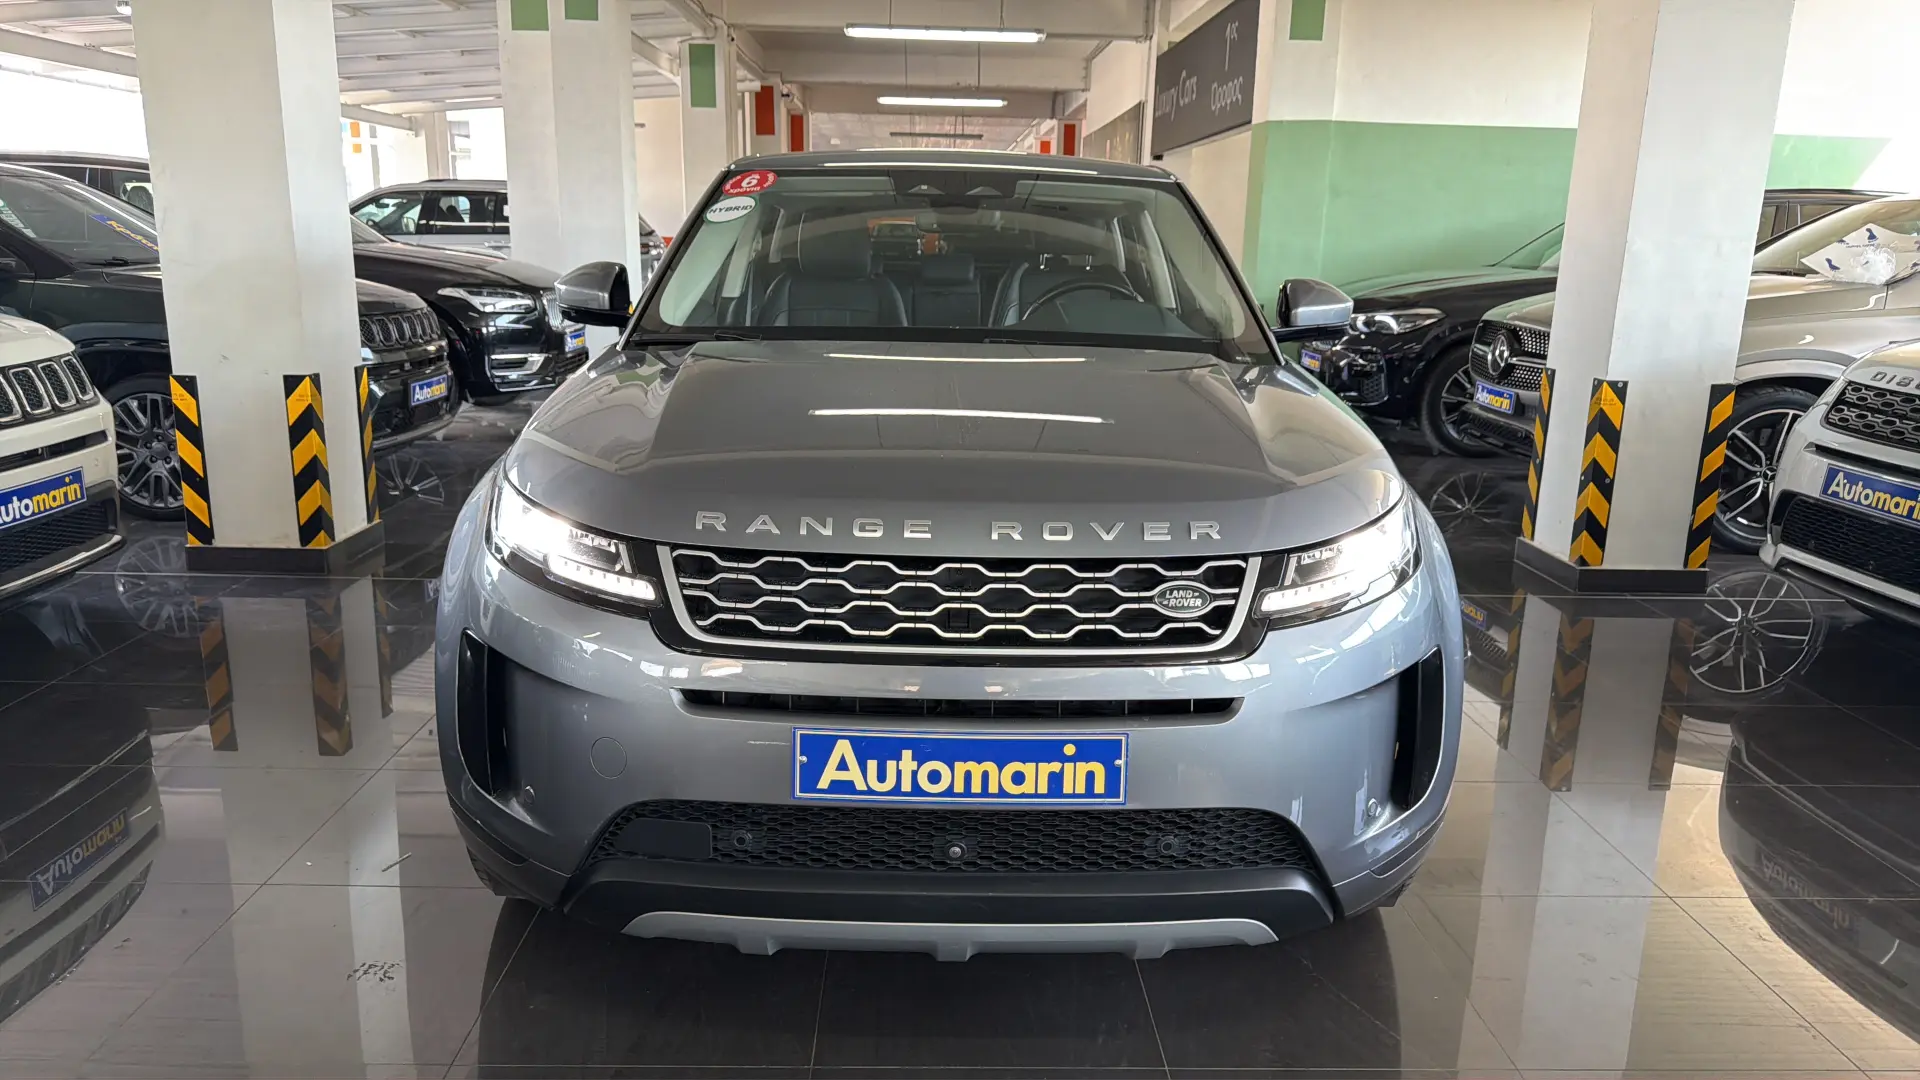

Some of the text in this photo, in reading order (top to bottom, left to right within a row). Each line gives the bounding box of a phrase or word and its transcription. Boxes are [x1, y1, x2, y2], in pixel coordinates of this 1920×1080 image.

[1179, 69, 1197, 107] Cars
[742, 175, 760, 187] 6
[708, 205, 753, 214] HYBRID
[0, 476, 81, 523] utomarin
[1827, 471, 1920, 519] Automari
[695, 511, 1221, 541] RANGE ROVER
[1165, 590, 1193, 598] LAND
[1169, 598, 1203, 607] ROVER
[816, 739, 1106, 795] Automarin
